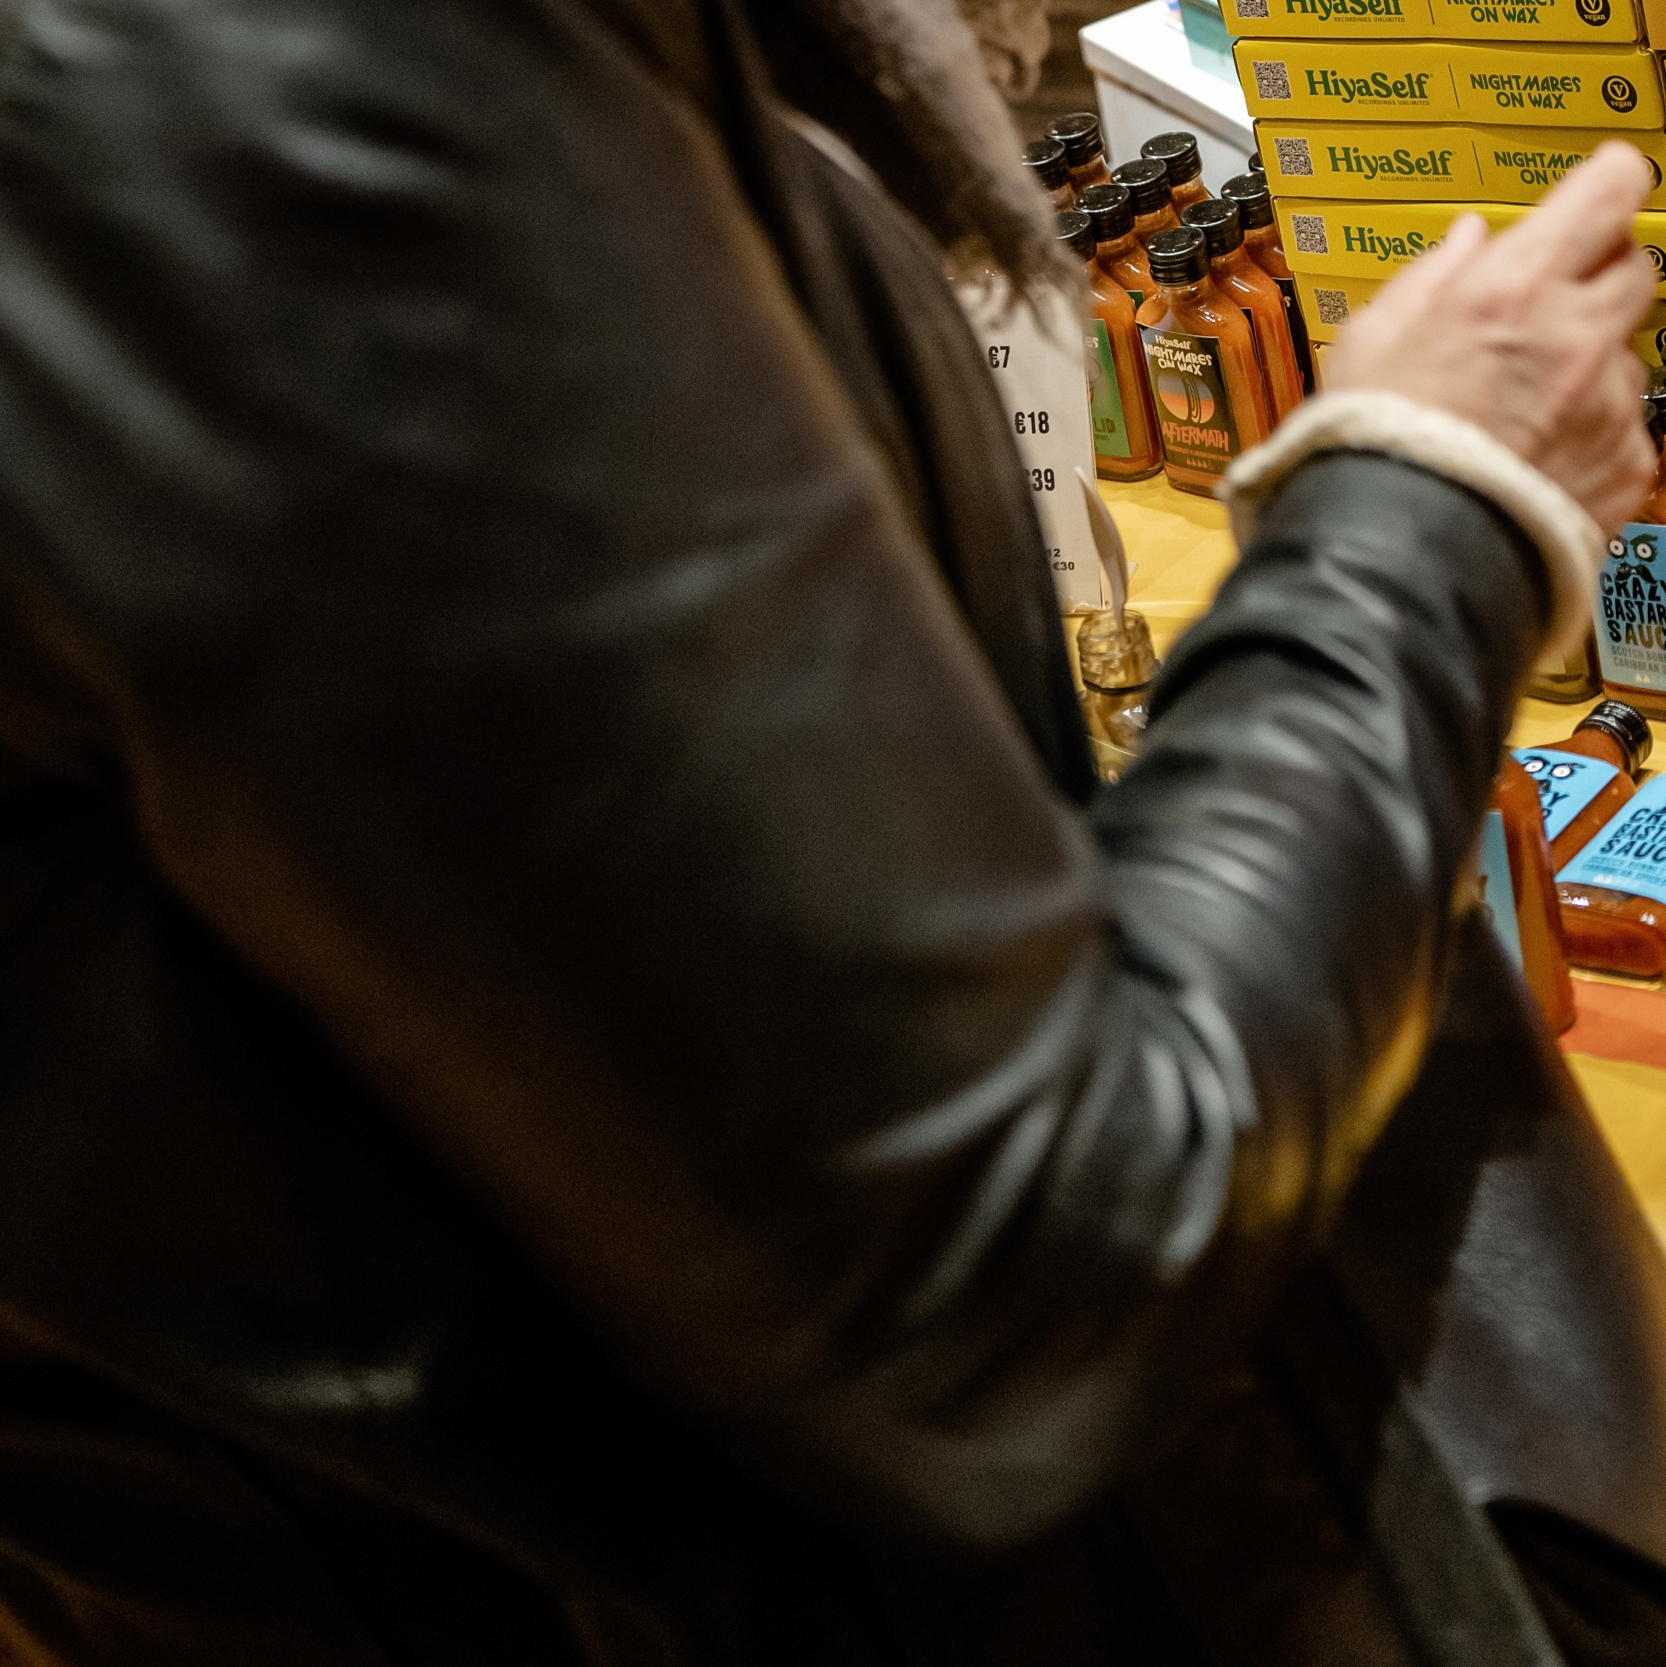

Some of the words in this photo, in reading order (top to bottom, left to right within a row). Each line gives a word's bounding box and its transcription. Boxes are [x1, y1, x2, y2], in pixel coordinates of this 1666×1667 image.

[1471, 7, 1498, 23] ON
[1502, 8, 1540, 24] WAX
[1584, 14, 1606, 22] vegan
[1305, 70, 1430, 104] HiyaSelf
[1469, 73, 1581, 93] NIGHTMARES
[1495, 91, 1524, 108] ON
[1527, 92, 1566, 110] WAX
[1610, 100, 1632, 109] vegan
[1327, 147, 1453, 180] HiyaSelf
[1155, 335, 1191, 350] HiyaSelf
[988, 345, 1010, 369] €7
[1144, 343, 1212, 366] NIGHTMARES
[1158, 358, 1176, 369] ON
[1177, 361, 1203, 376] WAX
[1014, 411, 1050, 434] €18
[1162, 420, 1229, 452] AFTERMATH
